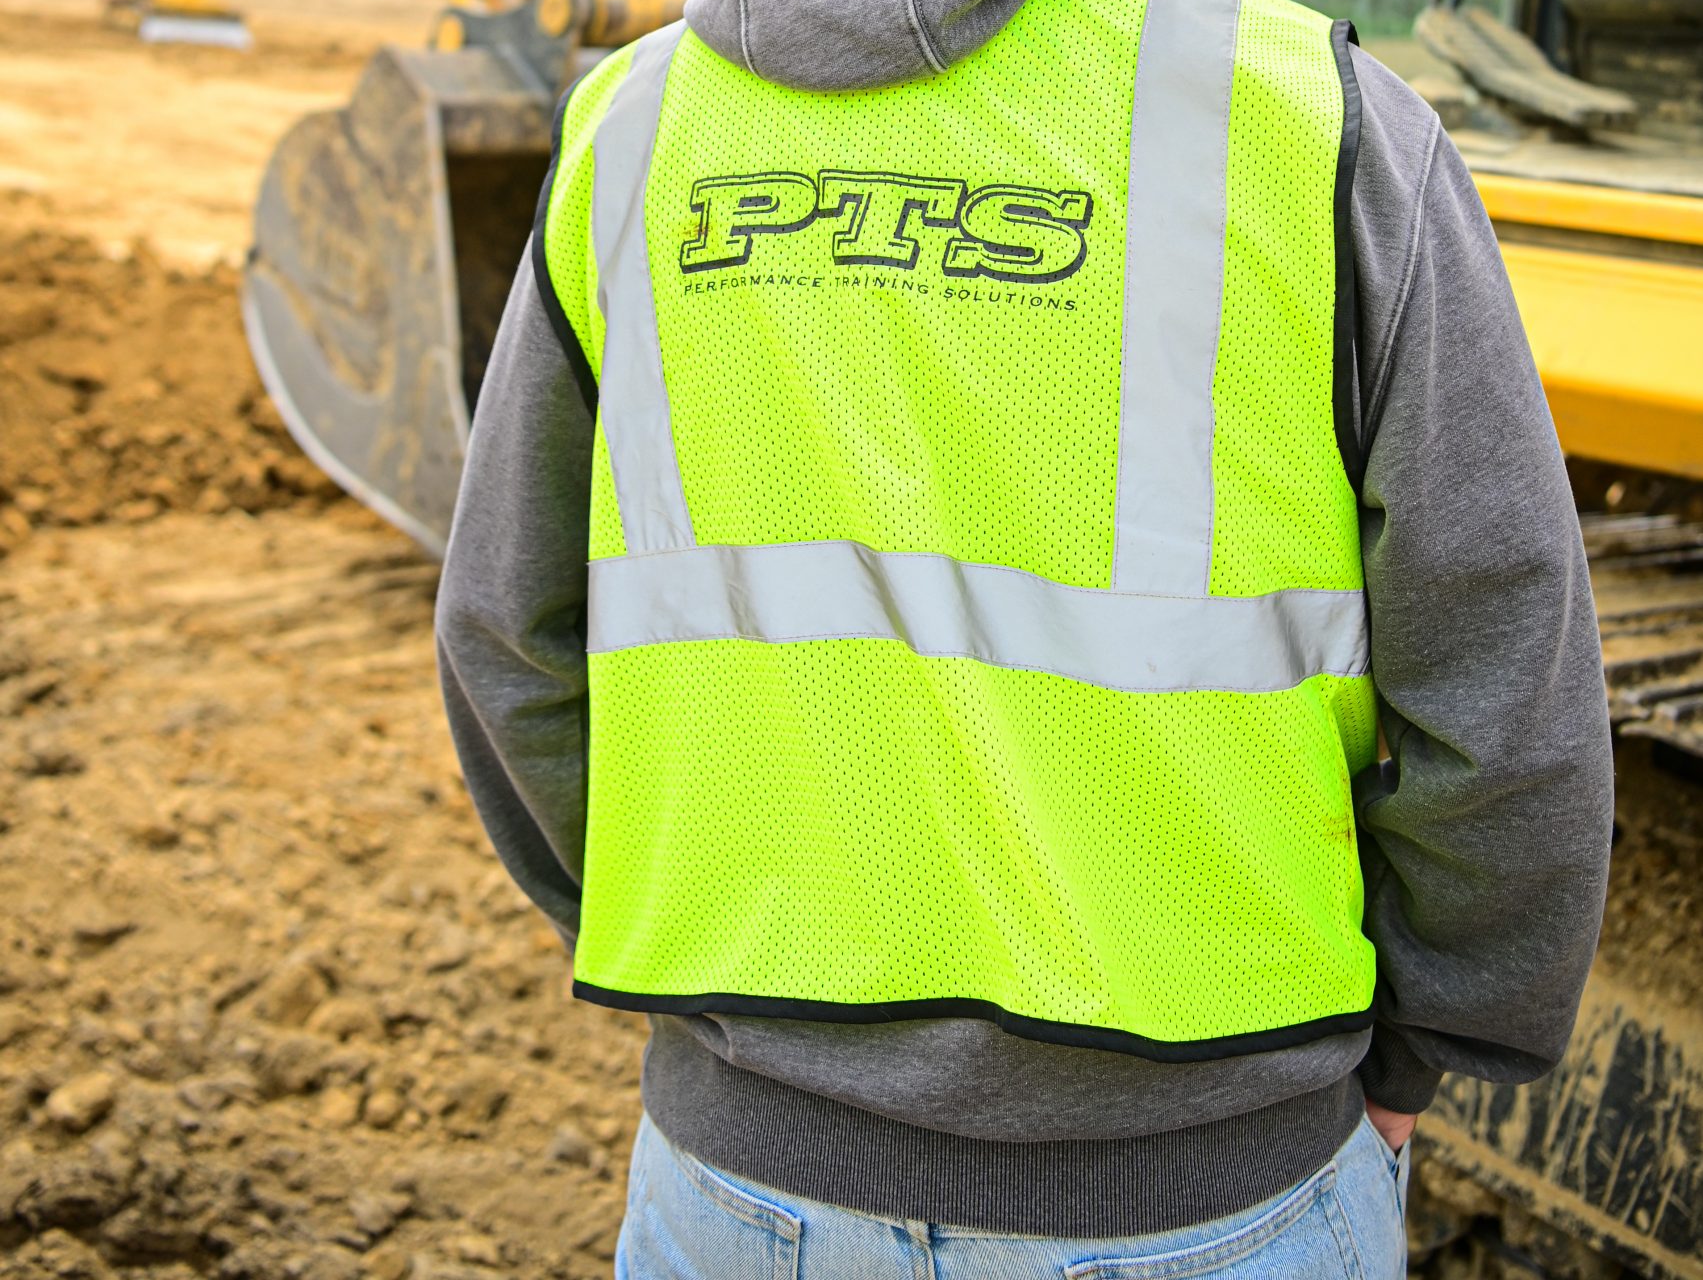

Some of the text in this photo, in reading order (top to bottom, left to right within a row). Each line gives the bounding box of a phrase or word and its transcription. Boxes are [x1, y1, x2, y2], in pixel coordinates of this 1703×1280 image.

[680, 169, 1093, 284] PTS
[683, 275, 1078, 312] PERFORMANCE TRAINING SOLUTIONS
